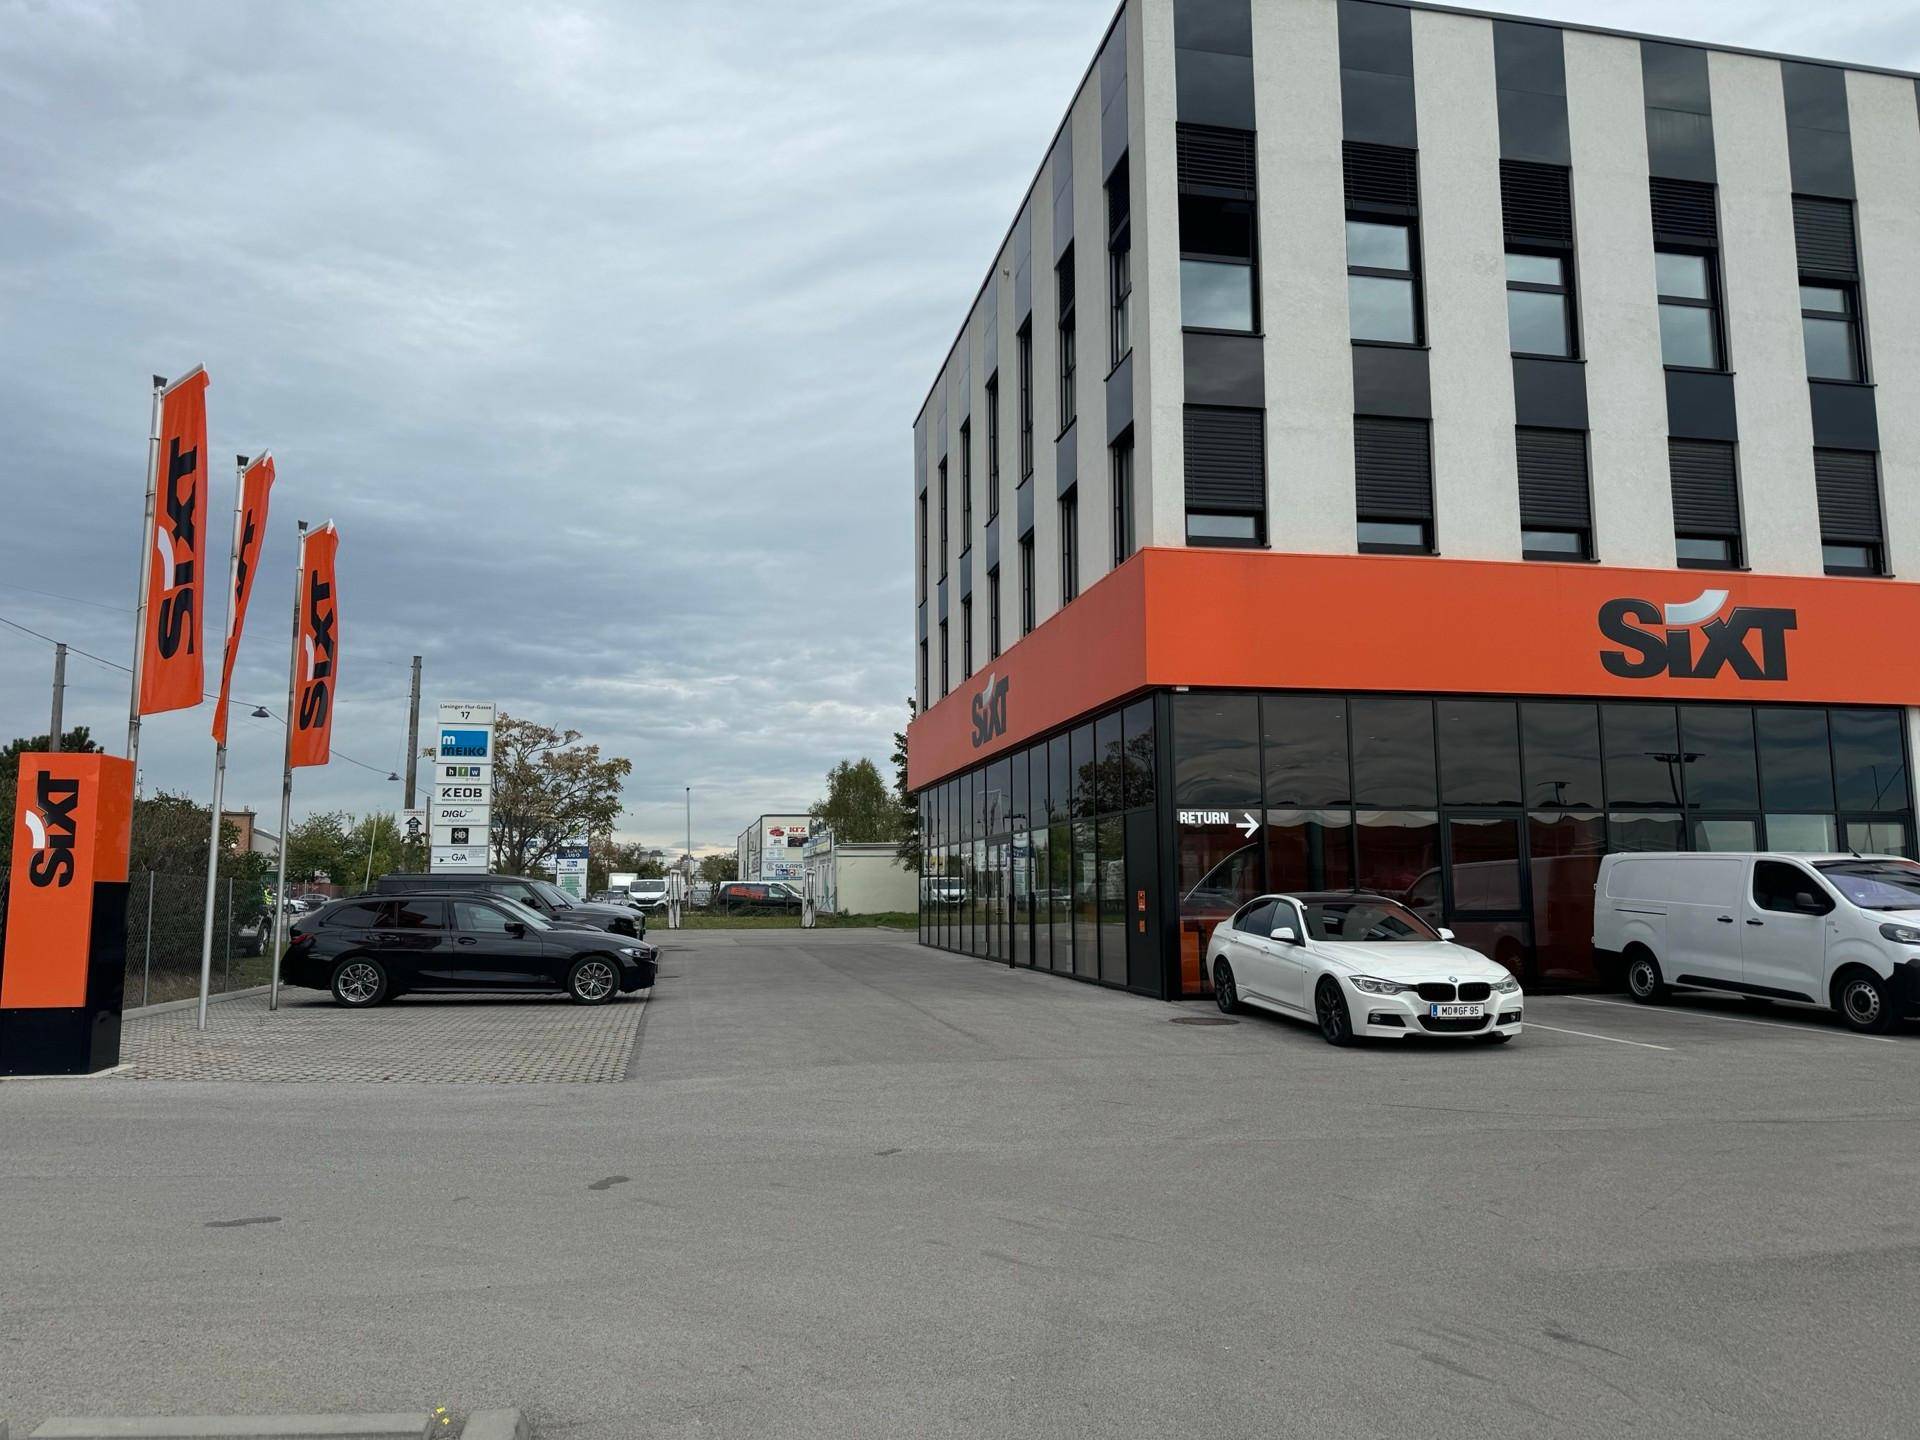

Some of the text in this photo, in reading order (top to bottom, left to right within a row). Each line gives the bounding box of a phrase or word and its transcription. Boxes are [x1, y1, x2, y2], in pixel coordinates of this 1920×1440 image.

[1597, 589, 1798, 681] SIXT
[460, 711, 471, 720] 17
[971, 672, 1009, 749] SIXT
[441, 746, 486, 756] MEIKO
[1179, 811, 1229, 824] RETURN
[25, 770, 80, 888] SIXT
[1441, 1006, 1479, 1016] MD GF 95
